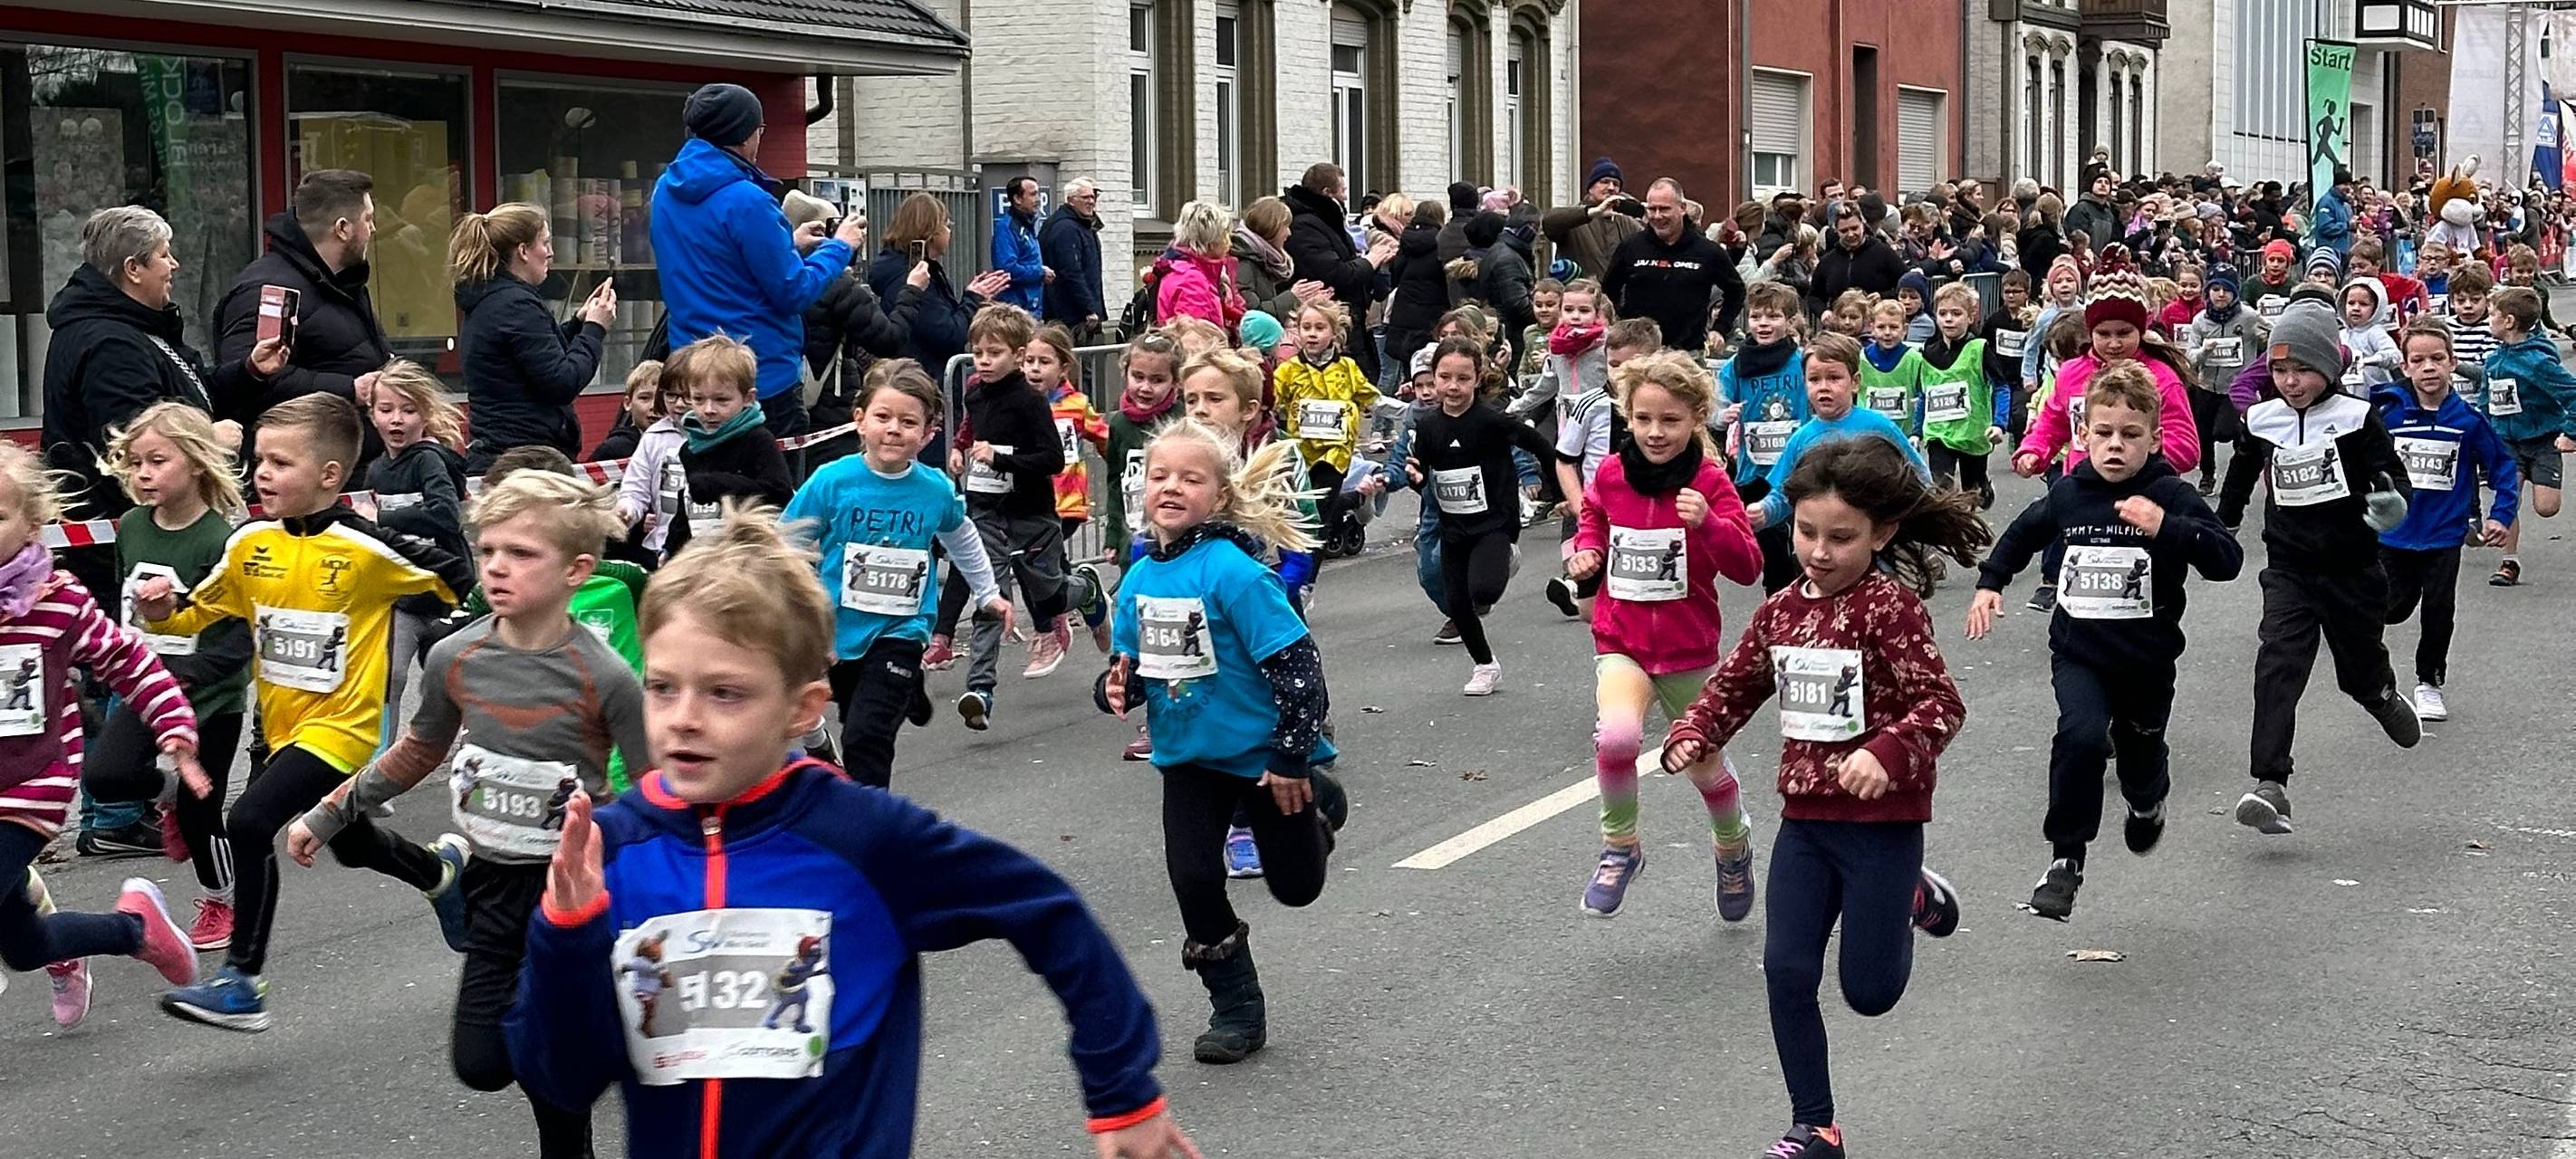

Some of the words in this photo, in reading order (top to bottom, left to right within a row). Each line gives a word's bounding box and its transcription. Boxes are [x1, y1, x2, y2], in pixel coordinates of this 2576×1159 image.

[2310, 48, 2350, 71] Start
[1751, 374, 1798, 395] PETRI
[2411, 455, 2443, 470] 5143
[2283, 465, 2320, 484] 5182
[1438, 485, 1466, 497] 5170
[851, 507, 924, 536] PETRI
[1621, 553, 1658, 573] 5133
[867, 570, 908, 589] 5178
[2081, 571, 2124, 590] 5138
[274, 637, 316, 659] 5191
[1790, 680, 1827, 704] 5181
[483, 787, 542, 819] 5193
